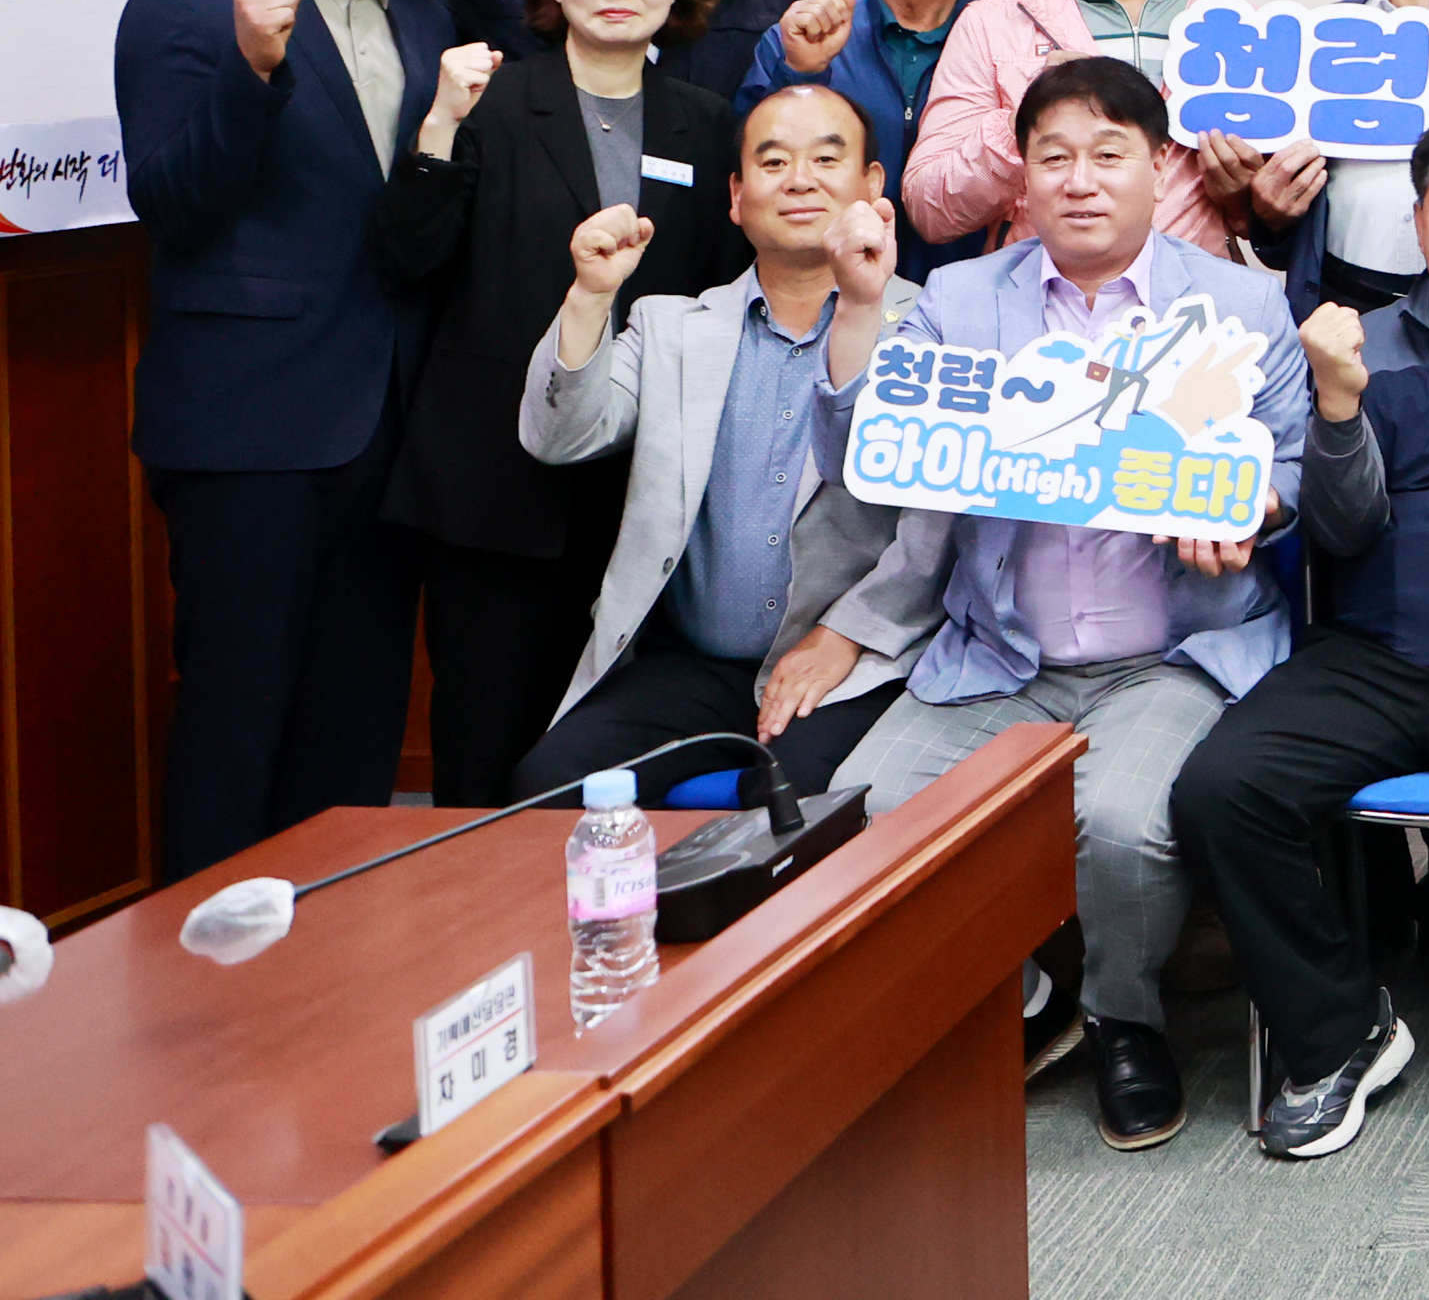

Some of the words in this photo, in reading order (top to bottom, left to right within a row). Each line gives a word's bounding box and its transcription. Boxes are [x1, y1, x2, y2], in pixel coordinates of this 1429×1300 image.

[51, 150, 92, 204] 시작
[97, 150, 120, 184] 더
[1112, 447, 1257, 522] 좋다!
